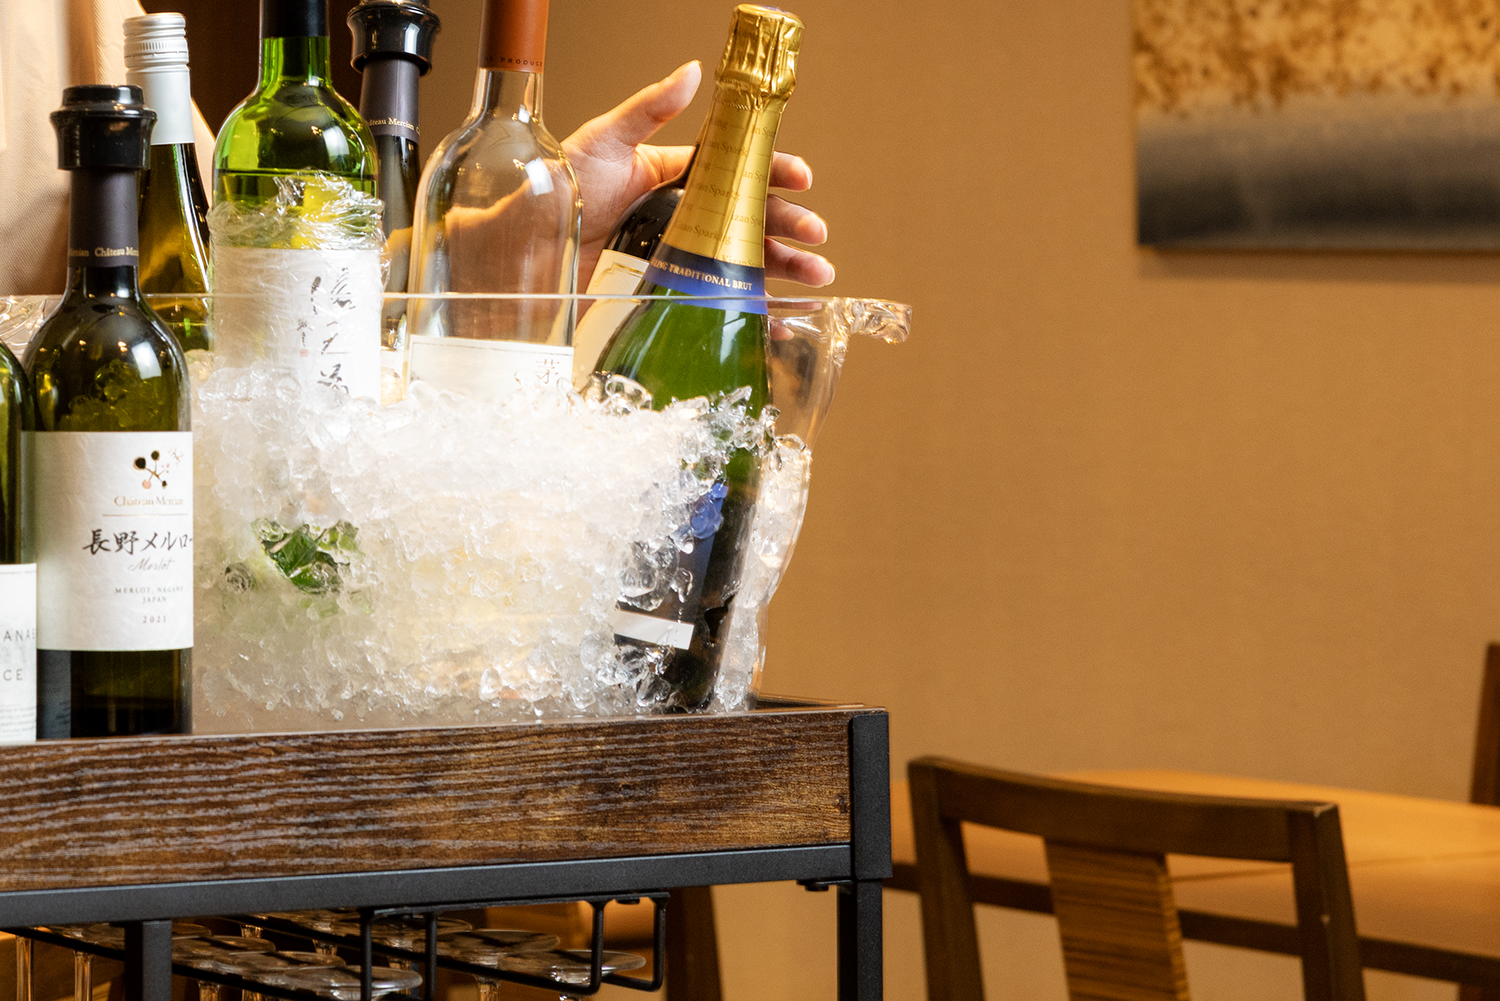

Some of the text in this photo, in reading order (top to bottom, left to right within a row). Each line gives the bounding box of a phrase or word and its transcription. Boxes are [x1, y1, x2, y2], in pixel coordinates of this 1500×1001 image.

[668, 262, 731, 287] TRADITIONAL
[732, 279, 753, 291] BRUT
[114, 495, 154, 507] Château
[127, 556, 176, 572] Merlot
[115, 586, 154, 595] MERLOT,
[142, 596, 167, 604] JAPAN
[142, 615, 167, 624] 2021
